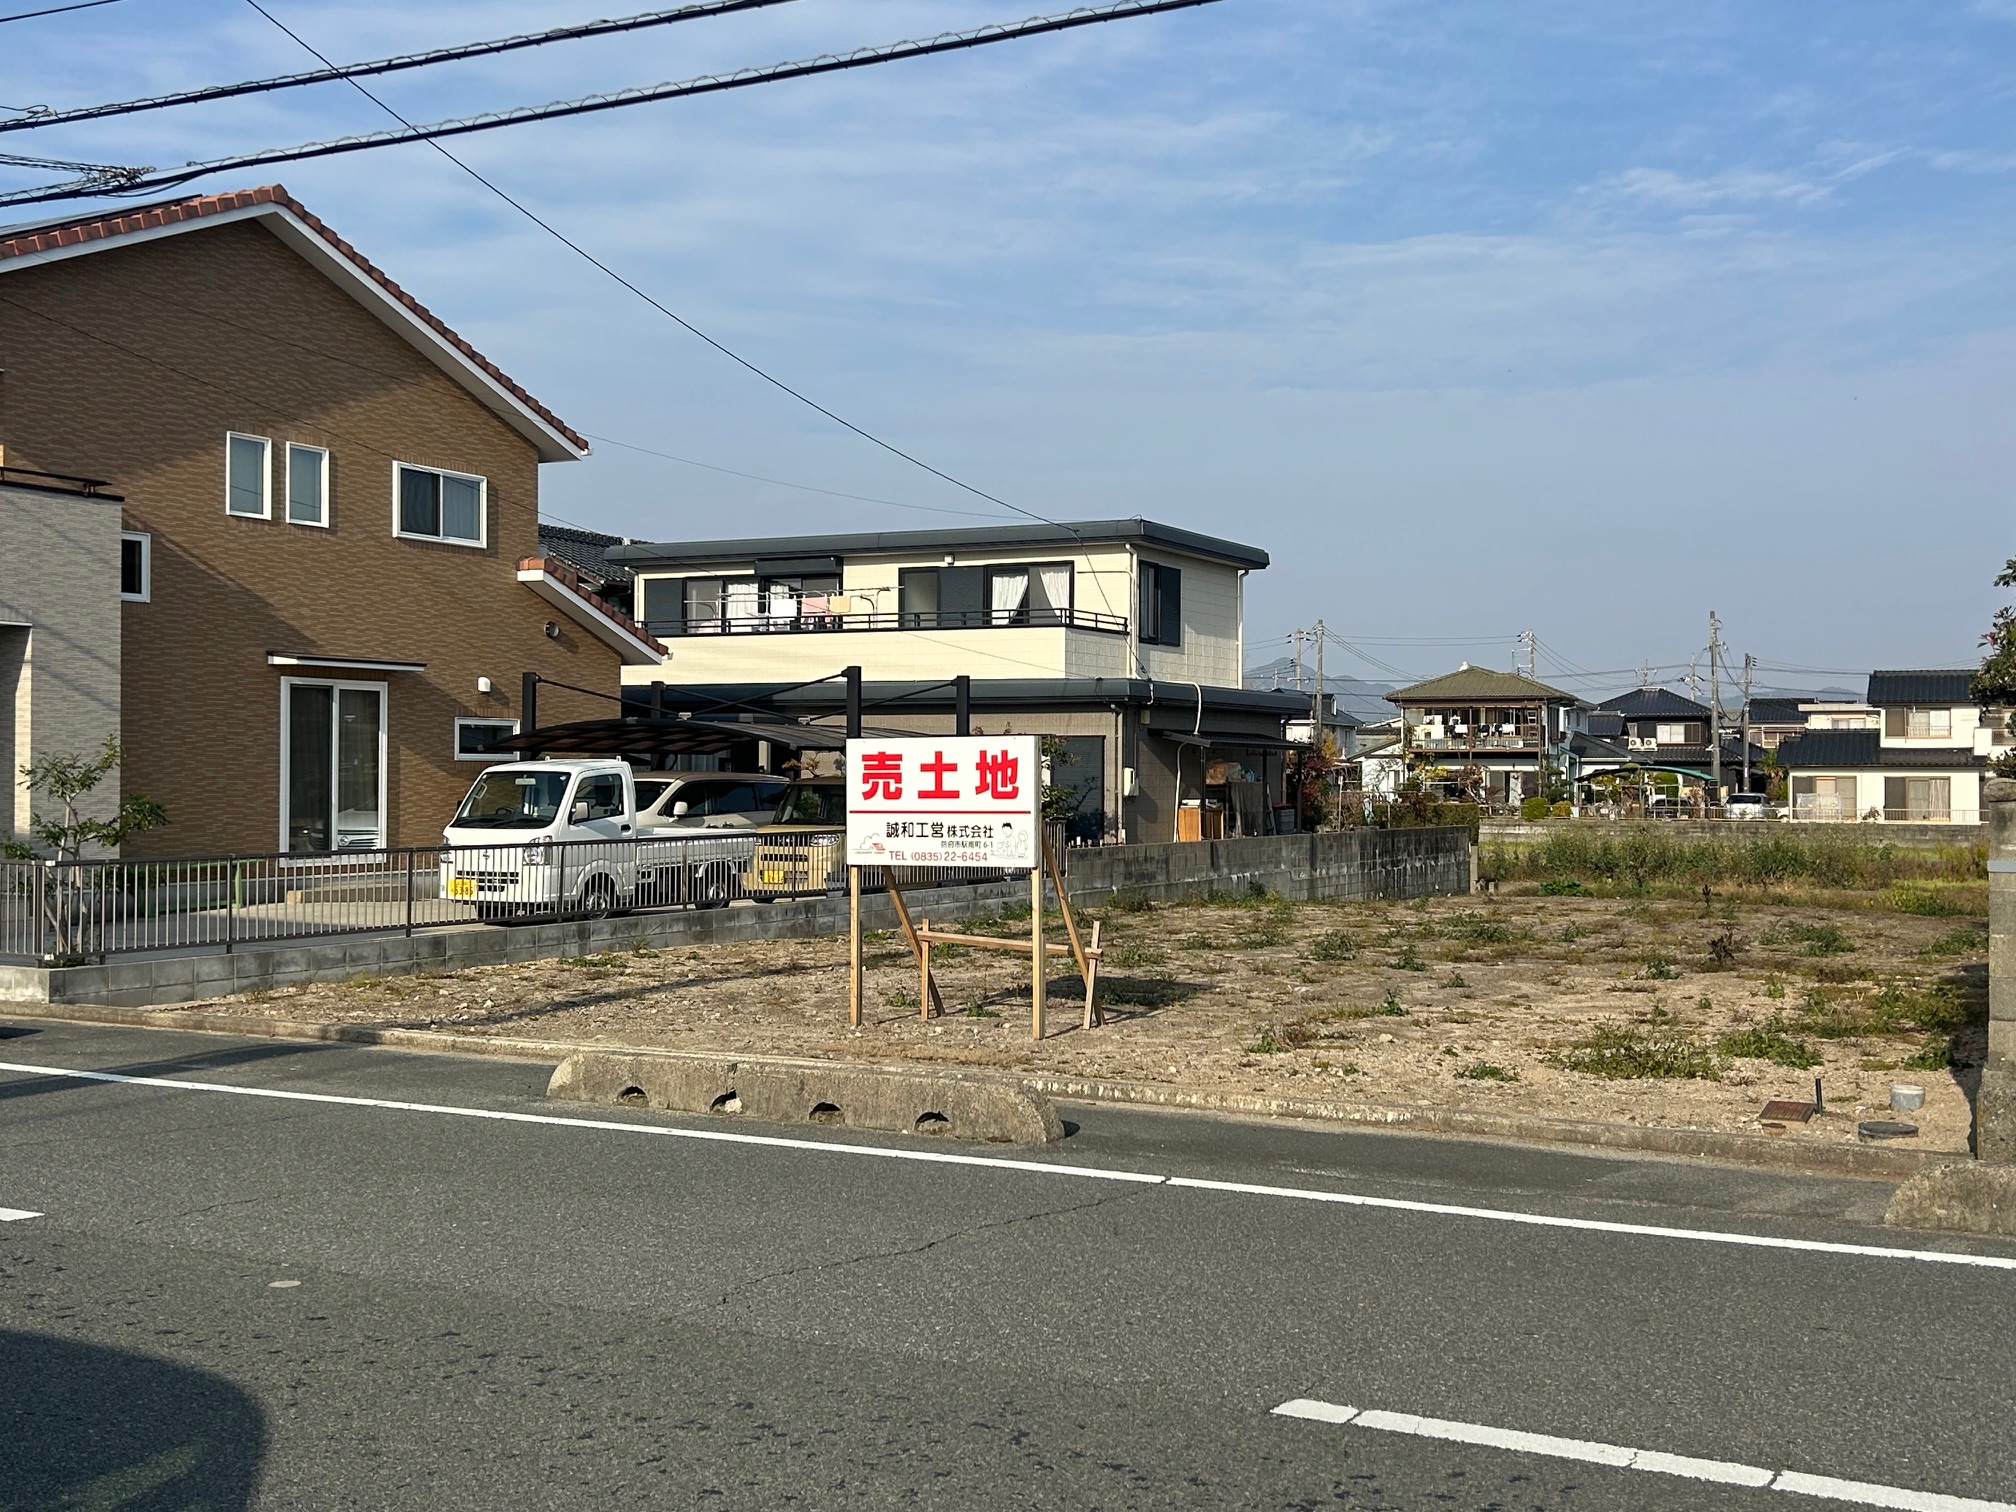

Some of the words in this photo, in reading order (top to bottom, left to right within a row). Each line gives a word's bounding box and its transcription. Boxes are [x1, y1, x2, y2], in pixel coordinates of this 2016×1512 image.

[862, 750, 1019, 800] 売土地
[889, 850, 907, 860] TEL
